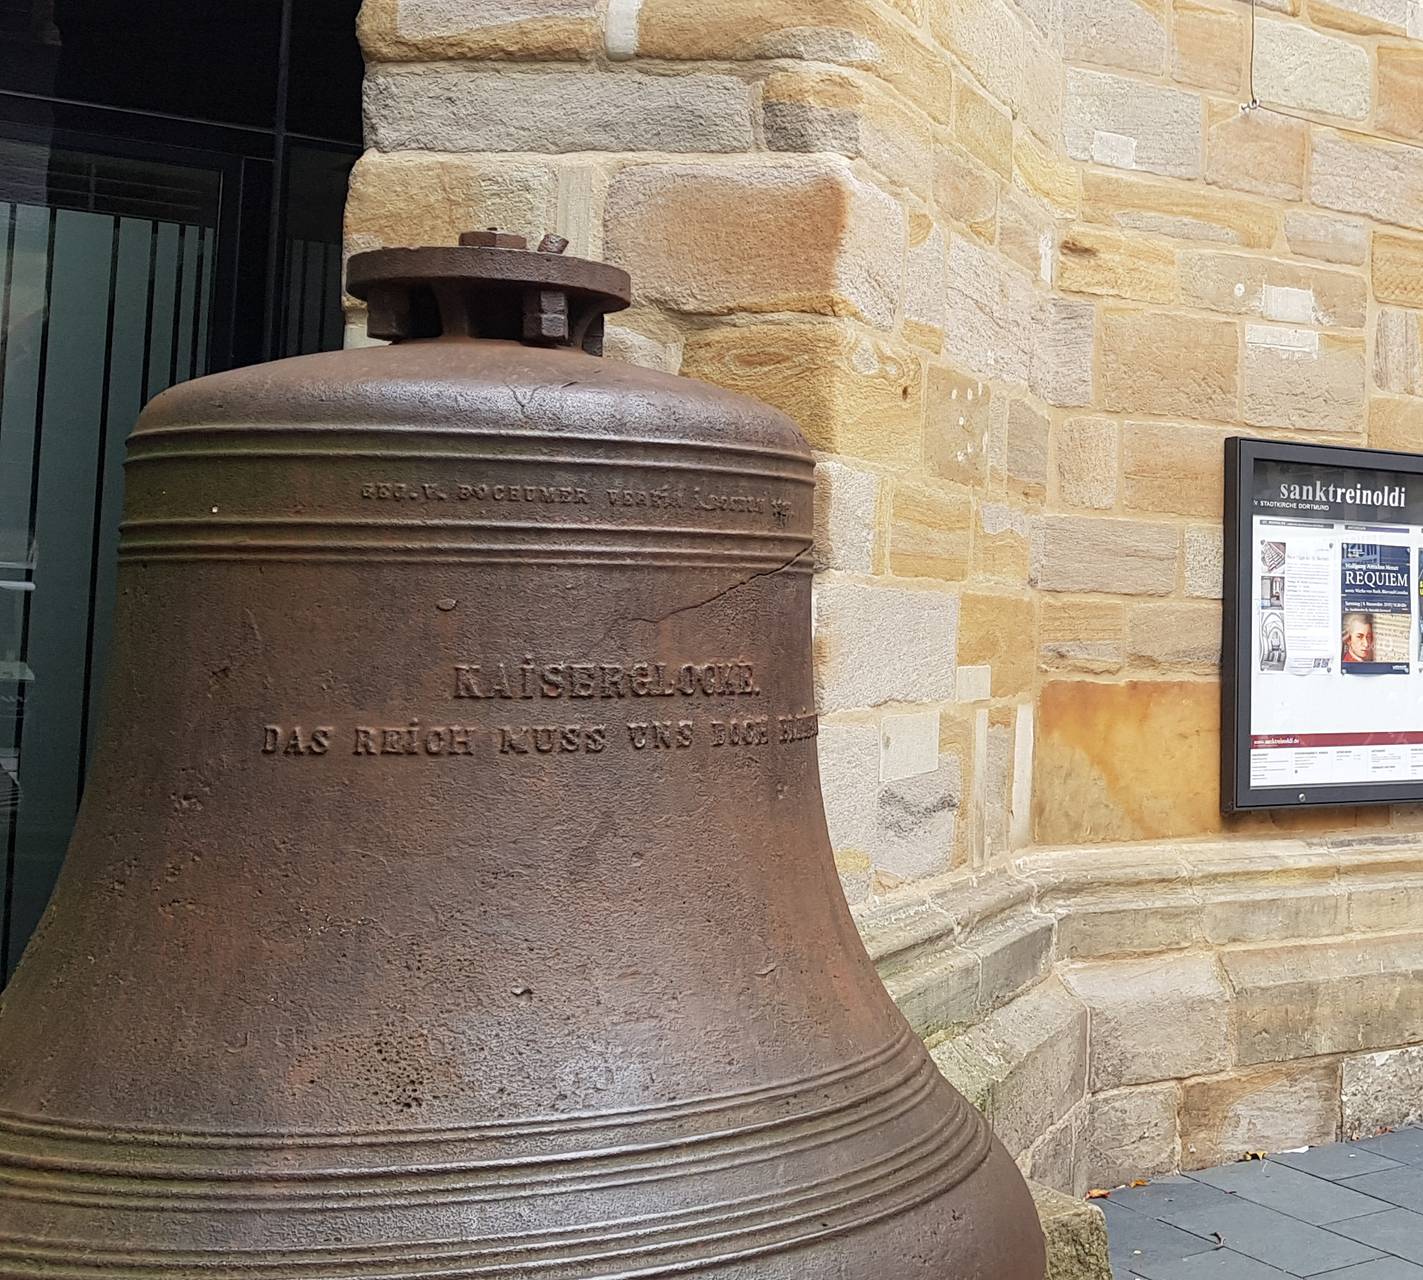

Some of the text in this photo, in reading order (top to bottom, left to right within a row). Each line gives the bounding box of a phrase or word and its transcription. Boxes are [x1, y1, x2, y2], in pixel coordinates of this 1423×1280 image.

[1279, 480, 1406, 508] sanktreinoldi
[1260, 500, 1298, 509] STADTKIRCHE
[1298, 502, 1330, 511] DORTMUND
[1345, 571, 1408, 588] REQUIEM
[261, 725, 335, 756] DAS
[499, 724, 607, 755] MUSS
[626, 719, 694, 749] UNS
